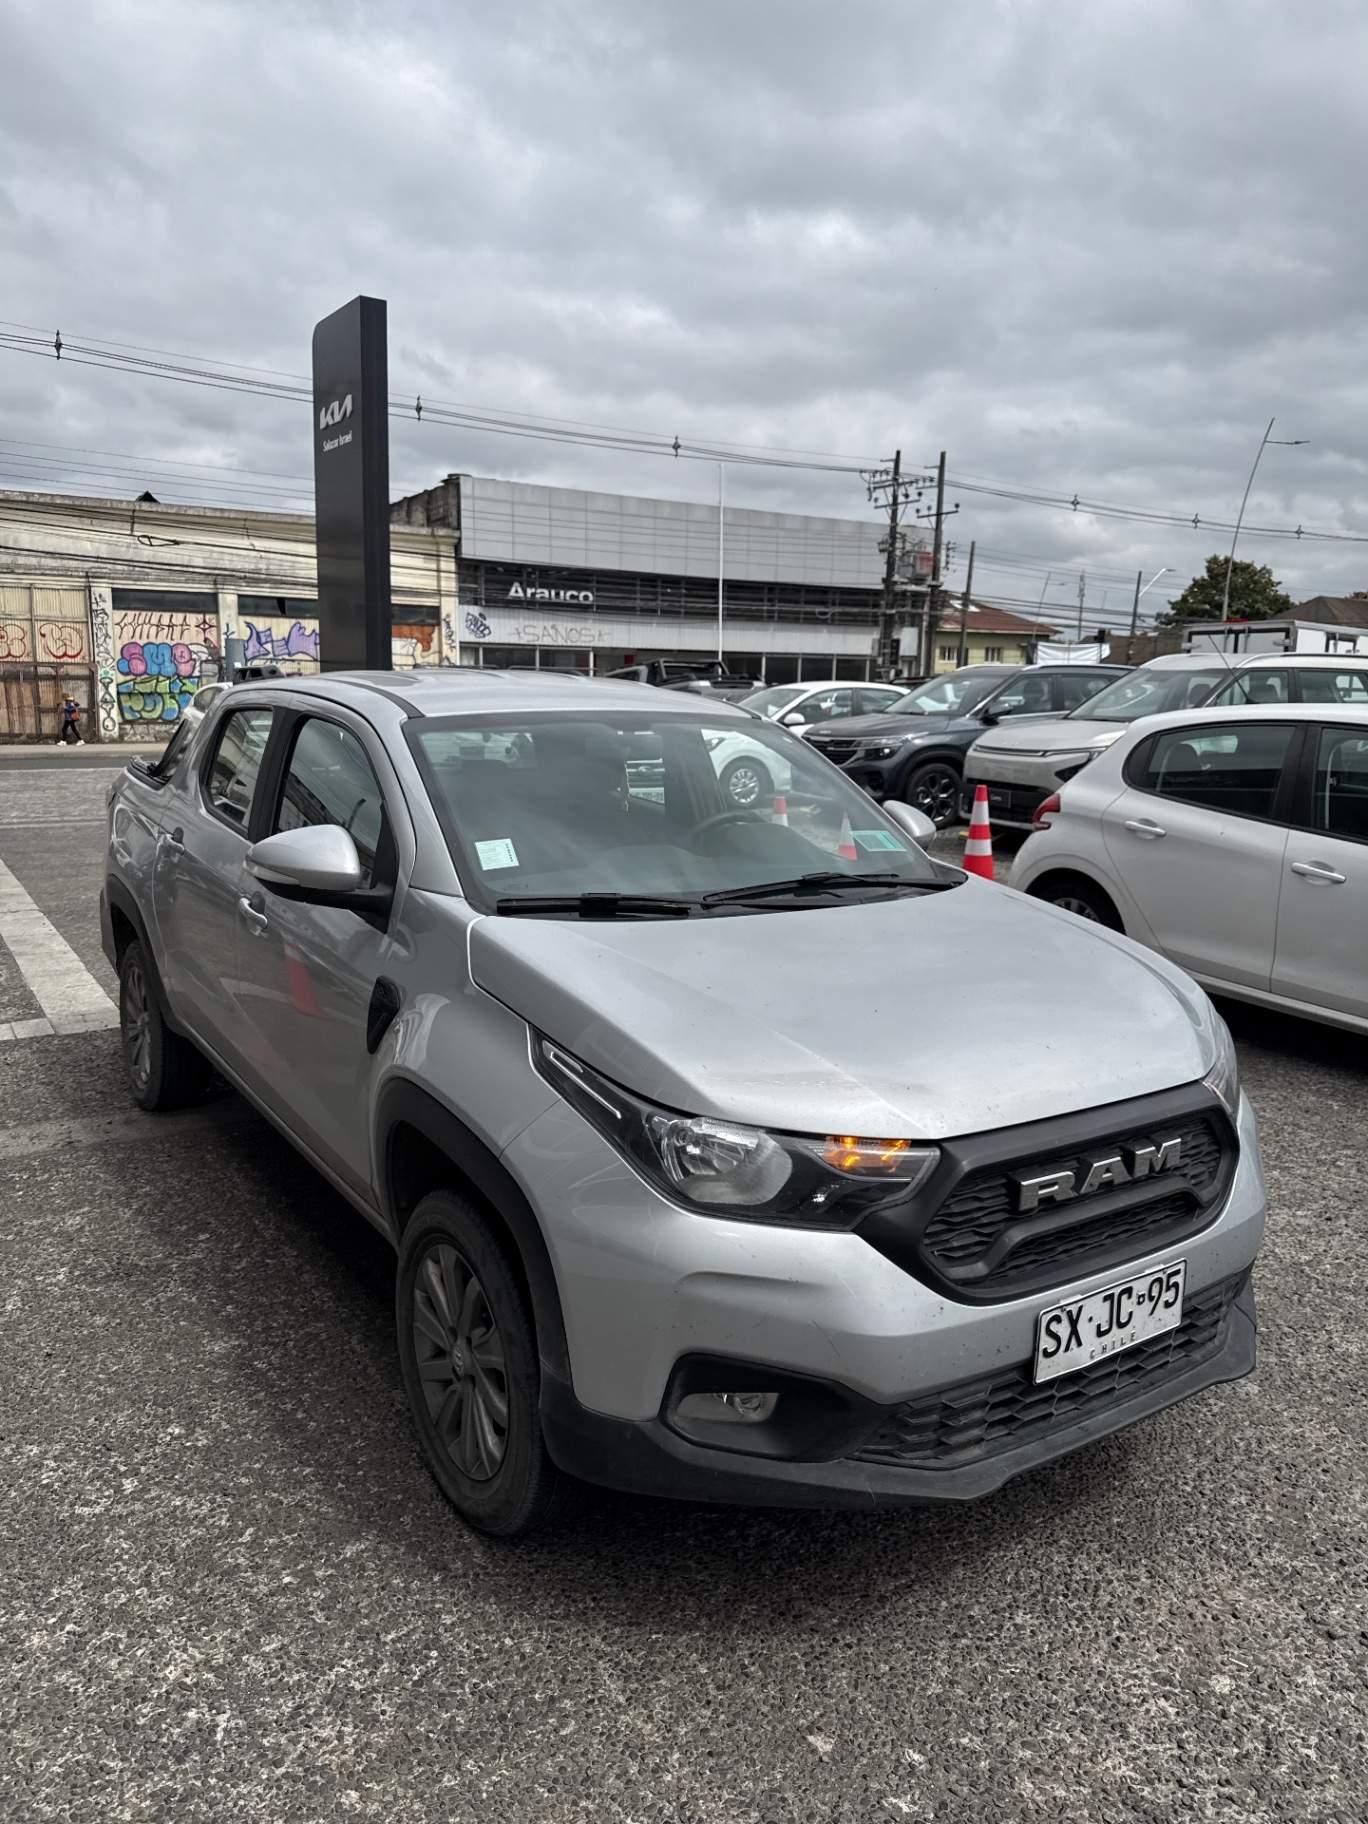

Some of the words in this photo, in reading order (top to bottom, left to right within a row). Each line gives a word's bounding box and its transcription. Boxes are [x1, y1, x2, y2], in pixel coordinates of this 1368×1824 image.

[508, 582, 593, 603] Arauco
[1018, 1138, 1182, 1211] RAM
[1089, 1331, 1137, 1360] CHILE
